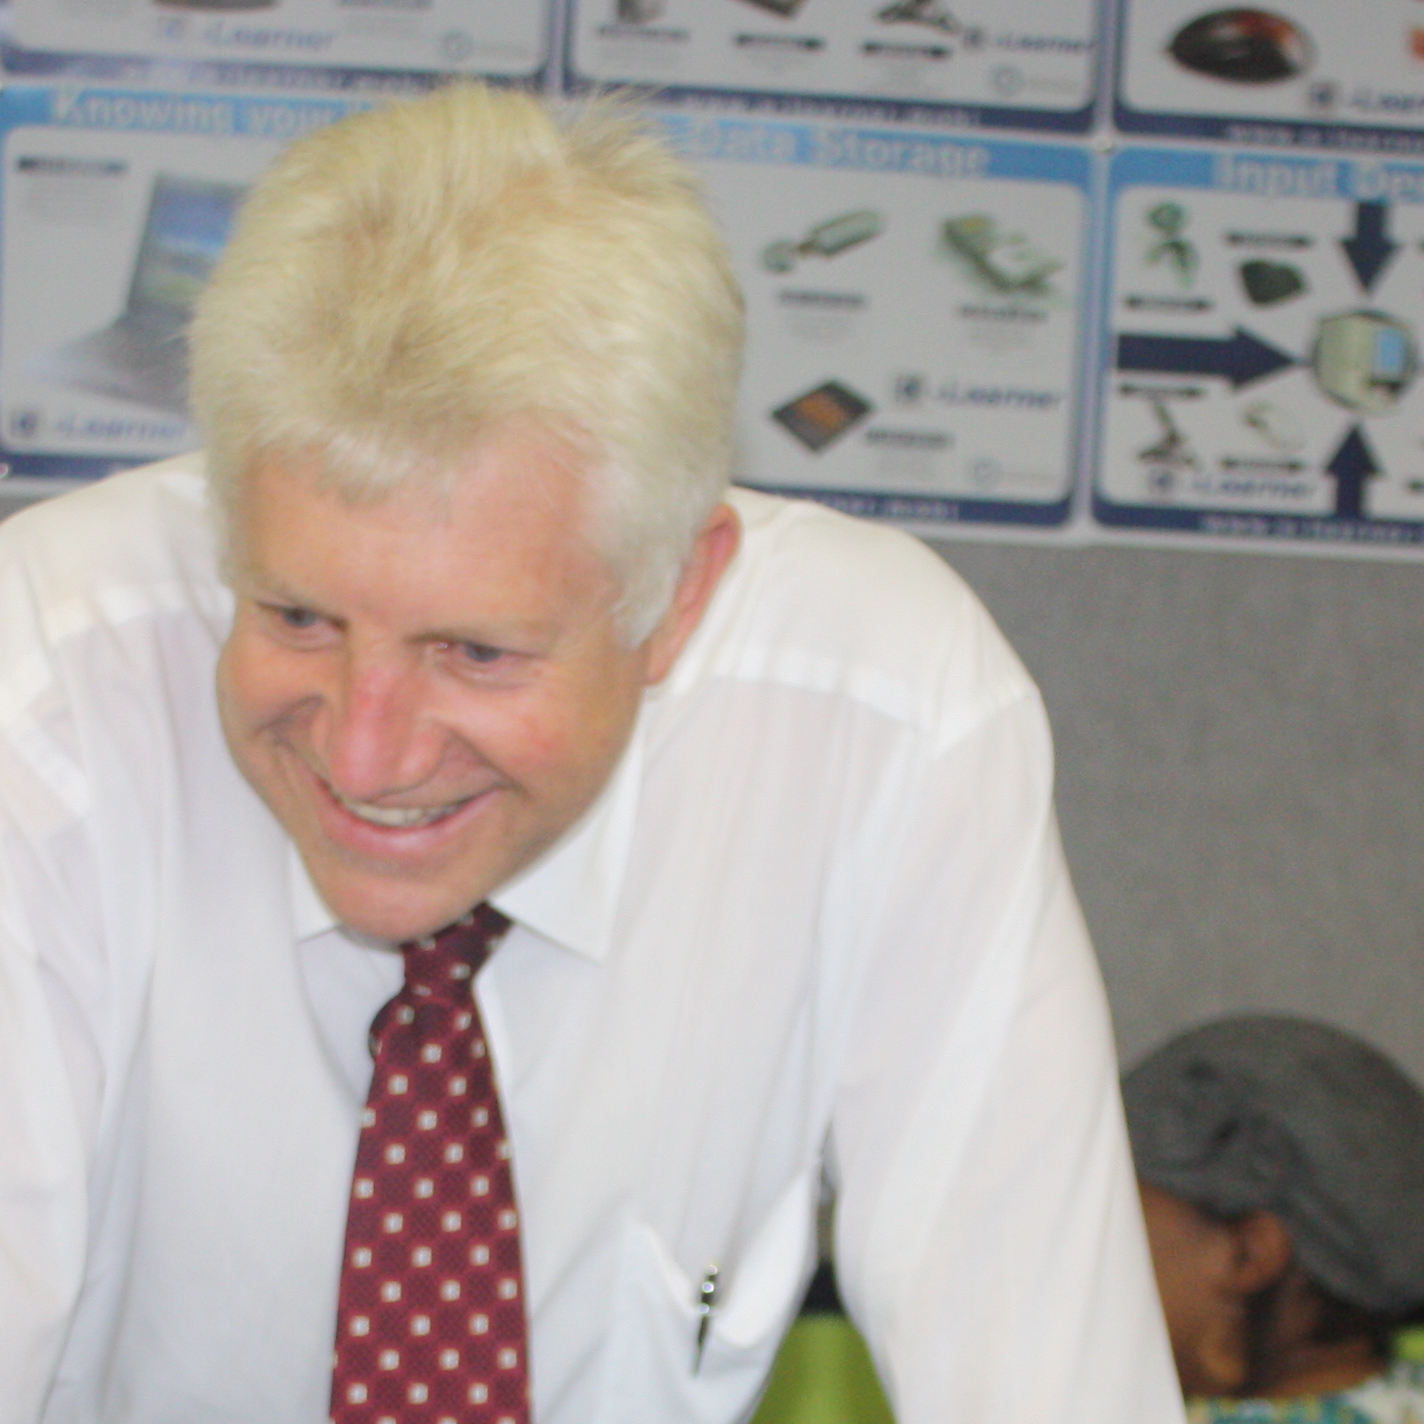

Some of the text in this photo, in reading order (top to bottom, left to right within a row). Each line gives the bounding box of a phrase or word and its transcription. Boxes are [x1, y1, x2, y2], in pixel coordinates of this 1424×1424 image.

[49, 86, 233, 136] Knowing
[688, 117, 993, 178] Data Storage
[1214, 155, 1340, 199] Input
